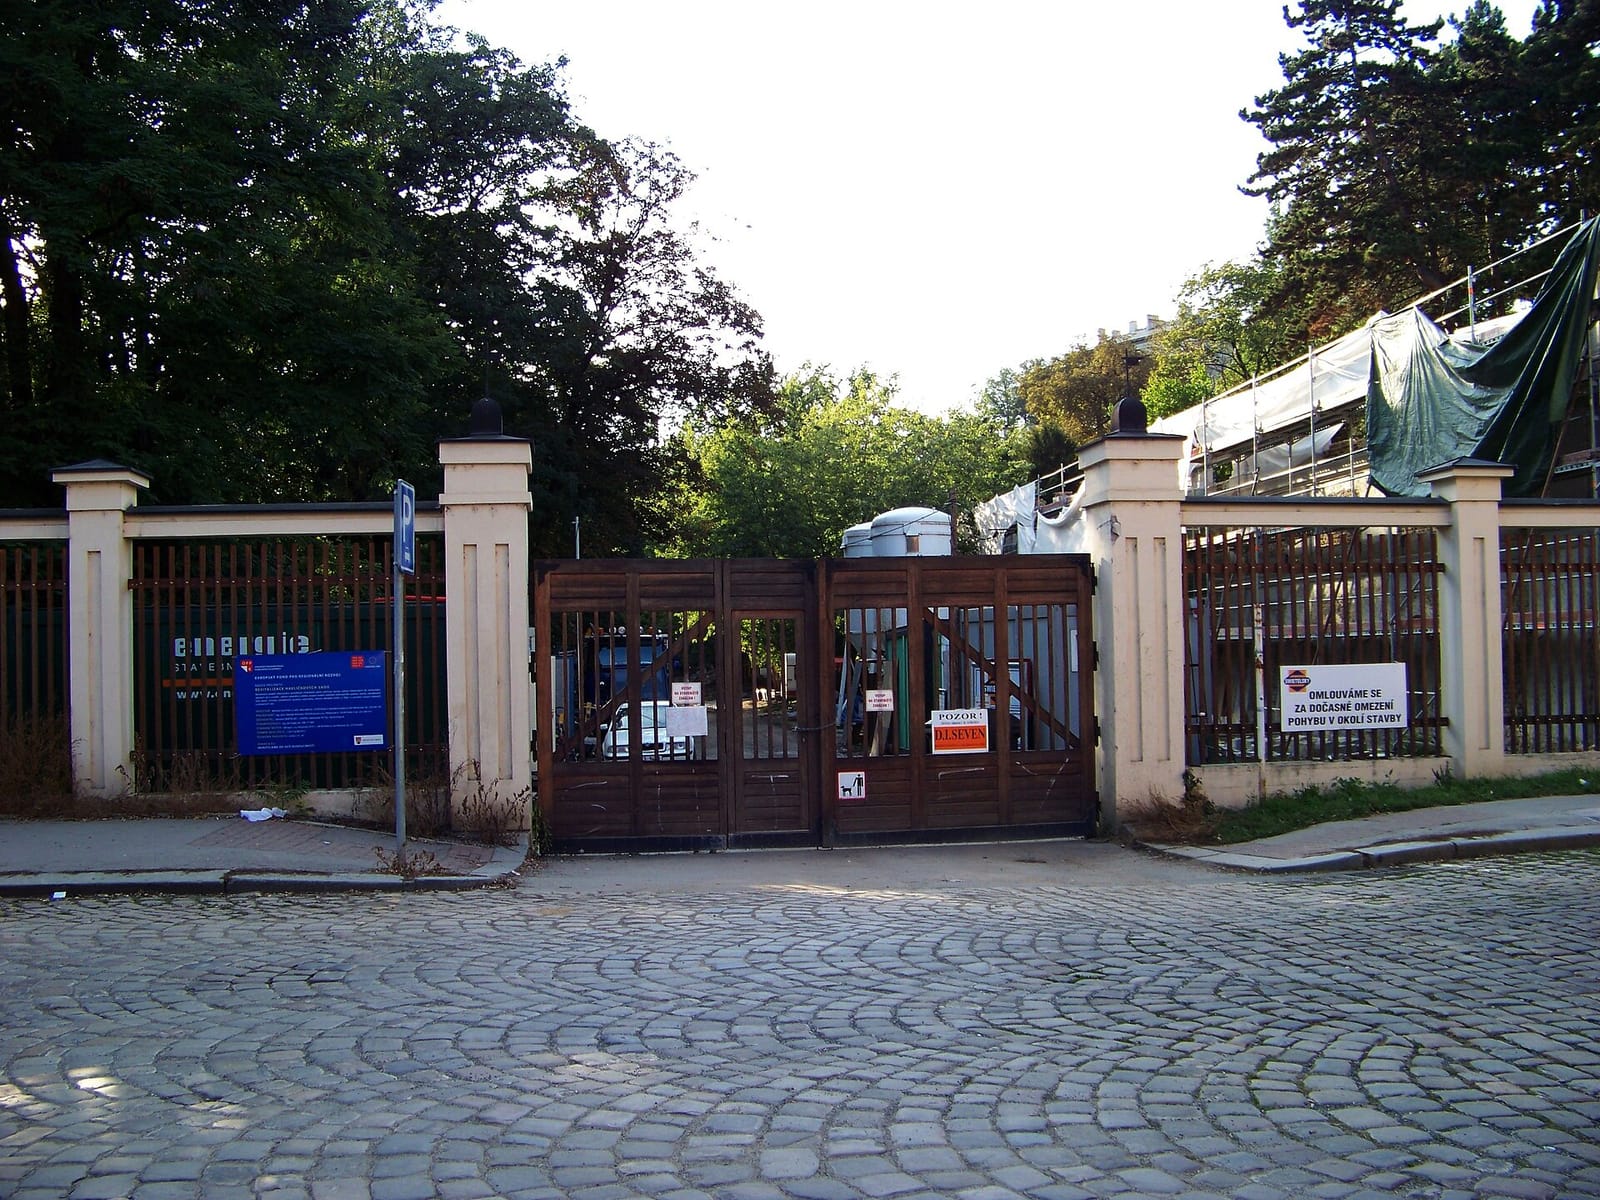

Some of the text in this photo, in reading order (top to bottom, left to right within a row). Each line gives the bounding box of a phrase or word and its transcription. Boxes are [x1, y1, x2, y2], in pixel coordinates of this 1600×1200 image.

[402, 494, 412, 543] P
[1309, 688, 1382, 700] OMLOUVÁME SE
[1294, 699, 1394, 713] ZA DOČASNÉ OMEZENÍ
[939, 712, 977, 721] POZOR
[1288, 713, 1402, 726] POHYBU V OKOLÍ STAVBY
[935, 728, 986, 741] D.I.SEVEN
